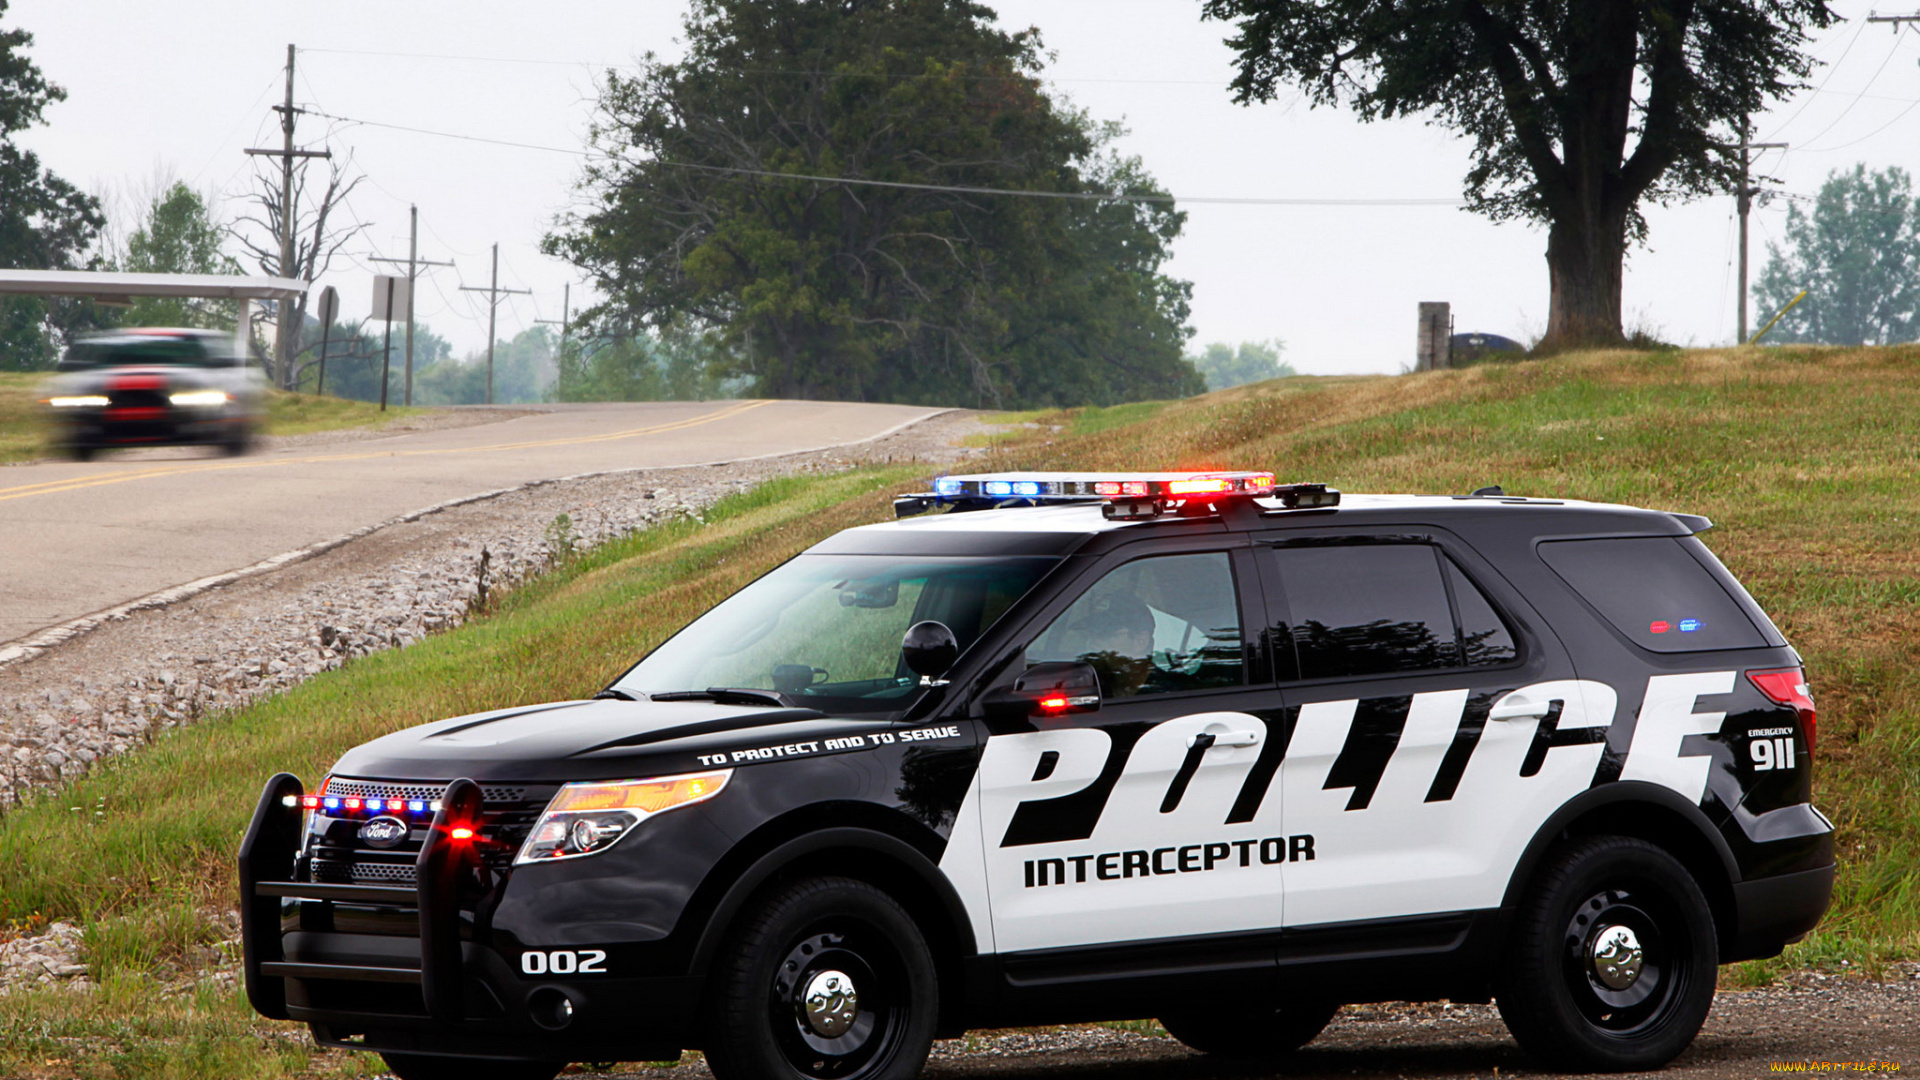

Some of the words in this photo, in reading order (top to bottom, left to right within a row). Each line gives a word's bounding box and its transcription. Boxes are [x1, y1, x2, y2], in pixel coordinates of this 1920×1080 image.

[1748, 727, 1793, 737] EMERGENCY
[698, 754, 727, 766] TO
[732, 741, 819, 762] PROTECT
[825, 735, 865, 750] AND
[868, 733, 895, 744] TO
[942, 670, 1737, 860] POLICE
[1750, 738, 1795, 771] 911
[367, 821, 393, 838] Ford
[1024, 834, 1315, 888] INTERCEPTOR
[521, 949, 607, 974] 002
